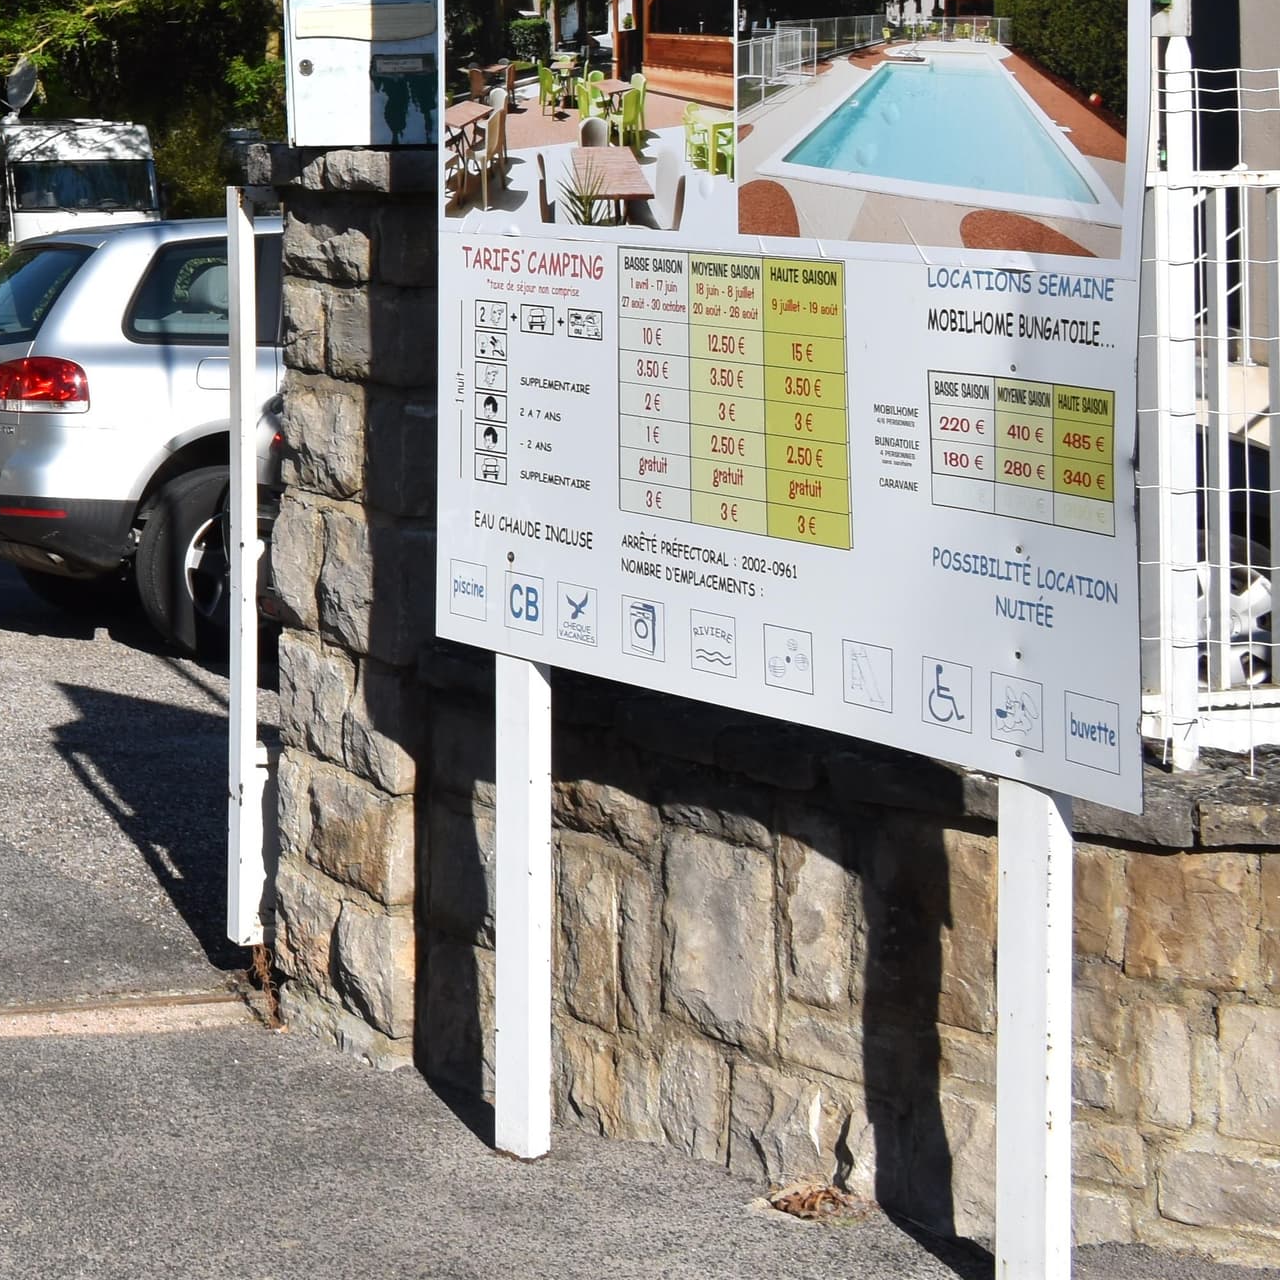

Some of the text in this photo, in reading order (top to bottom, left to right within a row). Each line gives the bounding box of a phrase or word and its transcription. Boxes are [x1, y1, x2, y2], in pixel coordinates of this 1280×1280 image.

[528, 251, 604, 280] CAMPING
[625, 256, 683, 274] BASSE SAISON
[692, 261, 760, 280] MOYENNE SAISON
[770, 267, 837, 286] HAUTE SAISON
[927, 267, 1114, 301] LOCATIONS SEMAINE
[507, 280, 514, 291] de
[538, 285, 549, 294] non
[552, 286, 579, 299] comprise
[656, 279, 663, 290] 17
[664, 280, 677, 294] juin
[696, 283, 754, 301] 18 juin 8 juillet
[651, 299, 660, 311] 30
[662, 299, 686, 313] octobre
[693, 303, 702, 314] 20
[772, 299, 838, 316] 9 juillet 19 août
[927, 308, 1013, 337] MOBILHOME
[643, 327, 652, 345] 10
[708, 334, 735, 354] 12.50
[792, 343, 802, 361] 15
[637, 359, 658, 378] 3.50
[710, 368, 734, 387] 3.50
[520, 377, 591, 394] SUPPLEMENTAIRE
[785, 376, 811, 396] 3.50
[935, 380, 989, 400] BASSE SAISON
[645, 393, 651, 411] 2
[998, 387, 1050, 408] MOYENNE SAISON
[1058, 394, 1108, 416] HAUTE SAISON
[520, 408, 561, 421] 2 A 7 ANS
[719, 403, 726, 420] 3
[874, 404, 918, 418] MOBILHOME
[795, 413, 801, 431] 3
[940, 416, 970, 433] 220
[1007, 424, 1030, 441] 410
[1062, 432, 1091, 450] 485
[527, 440, 552, 452] 2 ANS
[711, 435, 734, 455] 2.50
[875, 436, 920, 450] BUNGATOILE
[787, 446, 812, 466] 2.50
[944, 451, 969, 468] 180
[639, 457, 667, 475] gratuit
[1004, 460, 1031, 478] 280
[520, 471, 591, 491] SUPPLEMENTAIRE
[713, 468, 743, 487] gratuit
[879, 478, 918, 492] CARAVANE
[1063, 470, 1091, 488] 340
[789, 480, 822, 499] gratuit
[646, 490, 652, 508] 3
[721, 503, 728, 521] 3
[474, 510, 593, 550] EAU CHAUDE INCLUSE
[798, 515, 805, 534] 3
[622, 531, 797, 579] ARRÊTÉ PRÉFECTORAL 2002-0961
[622, 558, 755, 597] NOMBRE D'EMPLACEMENTS
[933, 547, 1118, 604] POSSIBILITÉ LOCATION
[453, 576, 484, 598] piscine
[510, 584, 539, 622] CB
[996, 595, 1054, 628] NUITÉE
[559, 629, 595, 644] VACANCES
[563, 621, 591, 634] CHEQUE
[693, 625, 733, 644] RIVIERE
[1071, 712, 1116, 746] buvette
